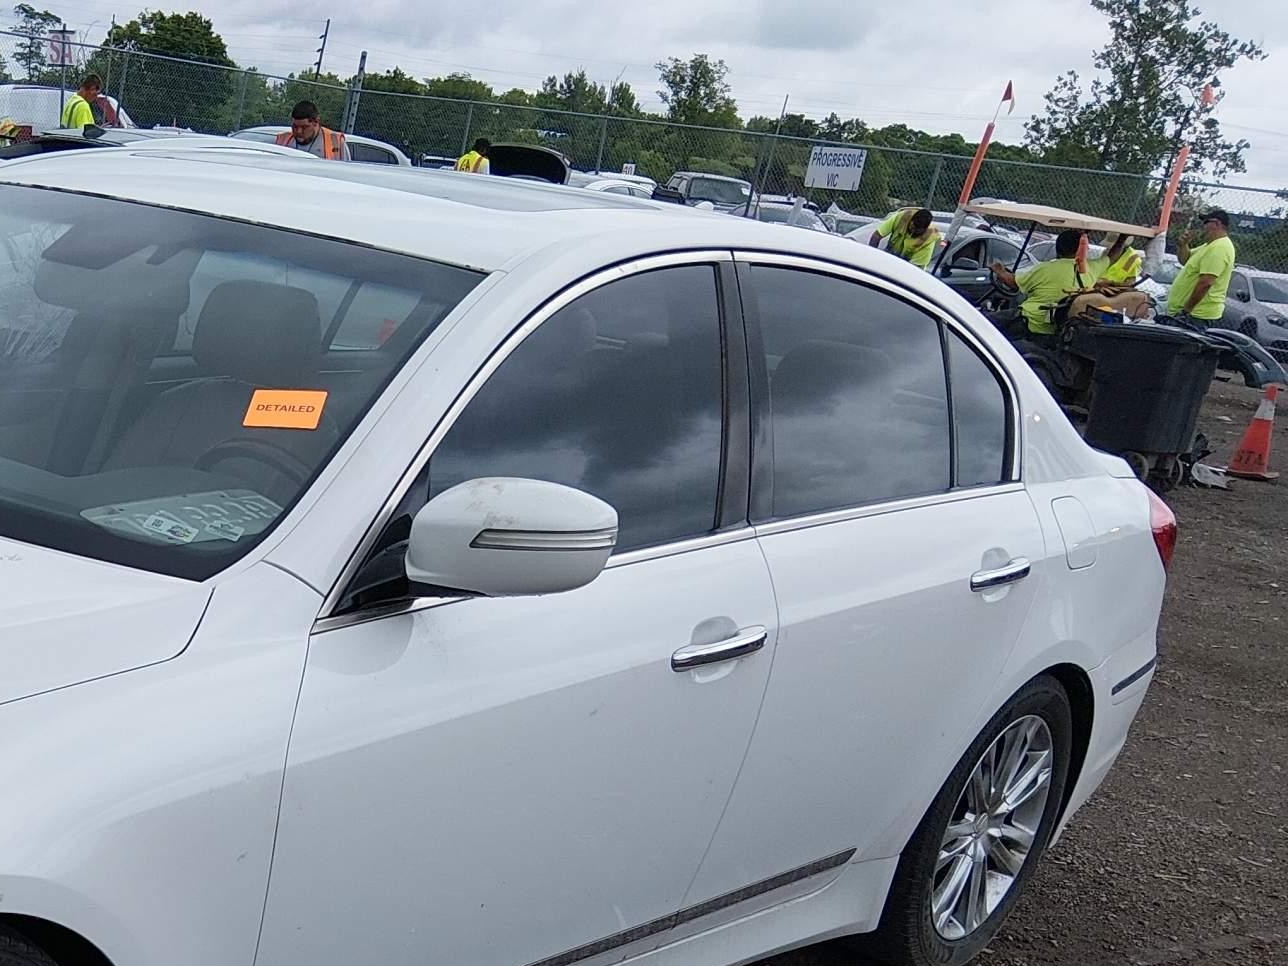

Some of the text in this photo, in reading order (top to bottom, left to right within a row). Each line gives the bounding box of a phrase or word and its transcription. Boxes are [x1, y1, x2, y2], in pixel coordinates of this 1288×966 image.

[812, 152, 864, 168] PROGRESSIVE
[826, 173, 840, 187] VIC
[255, 404, 316, 413] DETAILED
